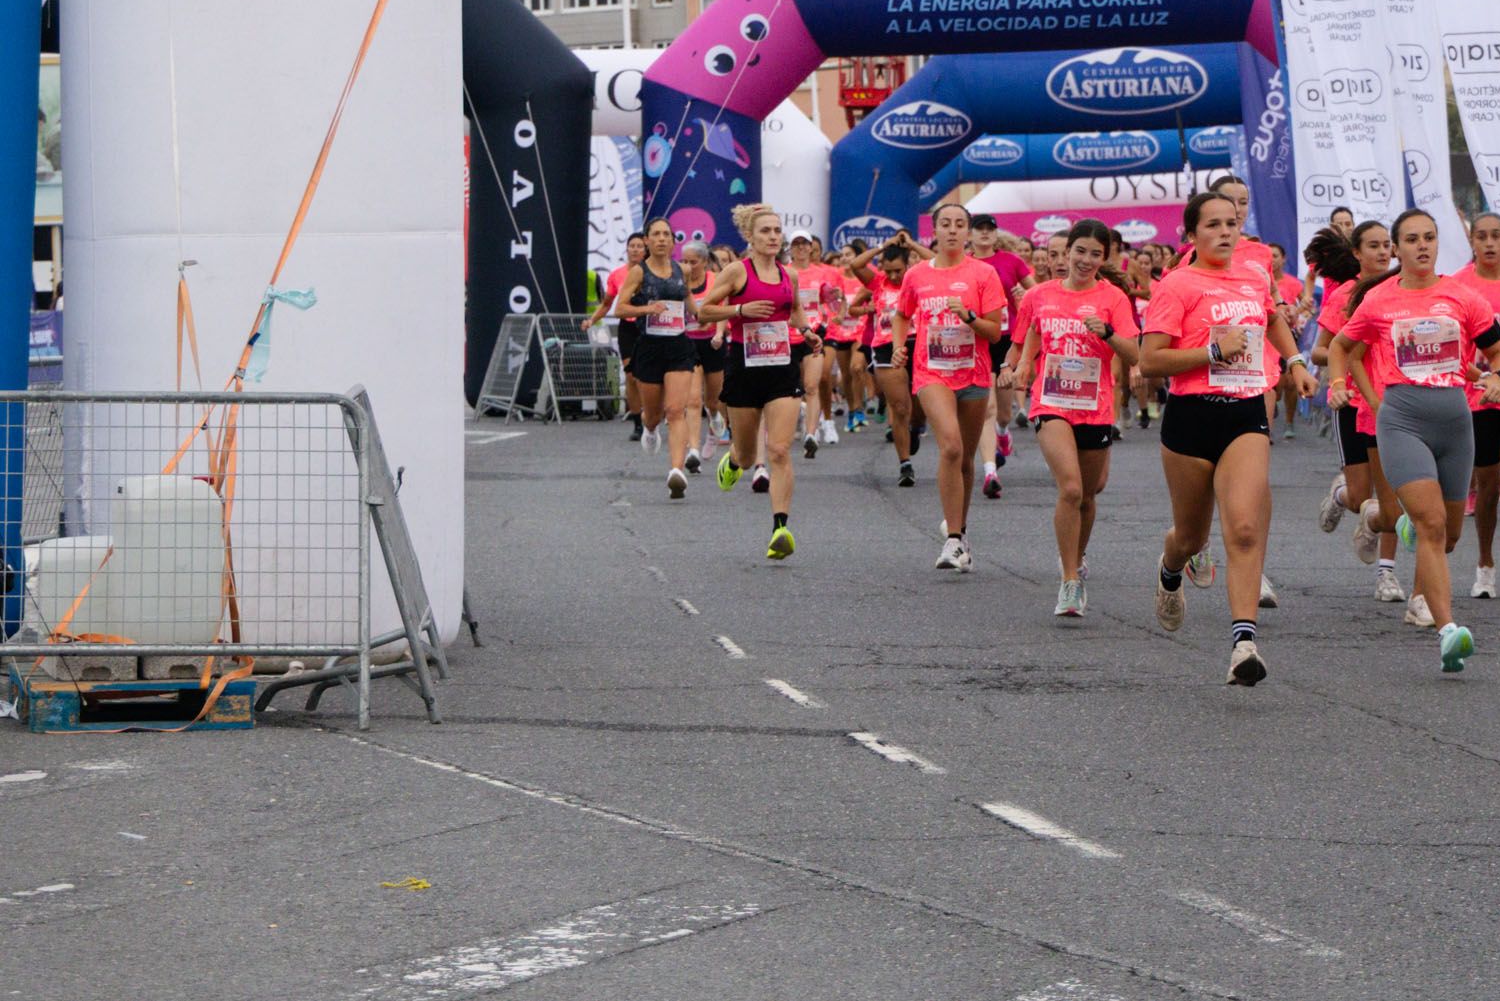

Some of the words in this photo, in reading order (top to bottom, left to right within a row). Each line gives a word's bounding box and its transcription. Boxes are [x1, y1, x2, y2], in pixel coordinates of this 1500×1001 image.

[886, 19, 900, 34] A
[907, 19, 932, 33] LA
[939, 16, 1058, 32] VELOCIDAD
[1064, 15, 1091, 29] DE
[1096, 14, 1123, 28] LA
[1129, 12, 1169, 26] LUZ
[507, 119, 537, 376] VOLVO
[1210, 301, 1263, 321] CARRERA
[1416, 343, 1441, 354] 016
